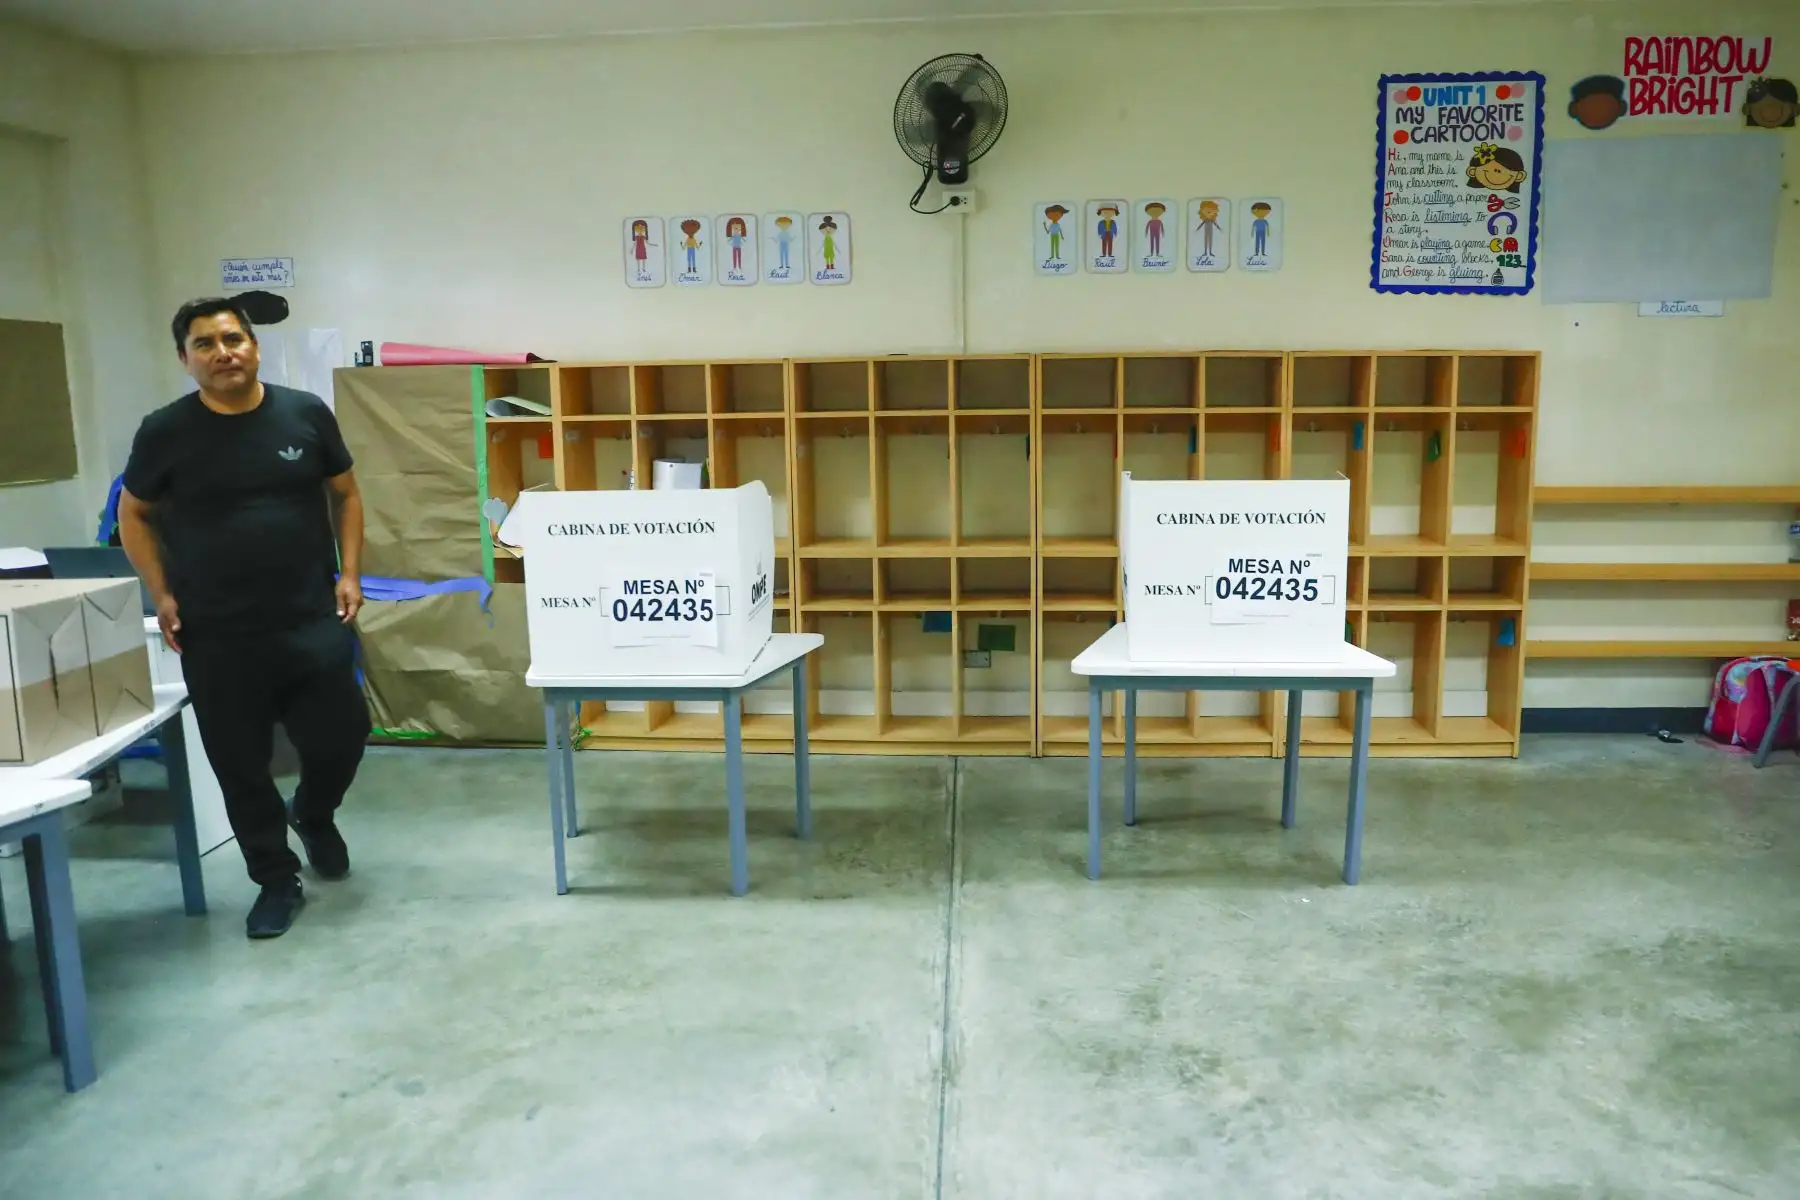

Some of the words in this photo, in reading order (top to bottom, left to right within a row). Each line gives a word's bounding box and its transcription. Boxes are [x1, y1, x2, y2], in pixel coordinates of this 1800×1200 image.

[1423, 85, 1473, 106] UNIT
[1476, 85, 1486, 105] 1
[1396, 105, 1424, 124] MY
[1410, 122, 1506, 143] CARTOON
[1409, 152, 1424, 166] my
[1426, 152, 1451, 161] name
[1455, 150, 1464, 161] is
[1388, 163, 1407, 175] Ana
[1409, 166, 1425, 175] and
[1427, 163, 1444, 175] this
[1446, 165, 1457, 175] is
[1386, 180, 1403, 192] my
[1406, 177, 1458, 189] classroom.
[1384, 192, 1410, 206] John
[1413, 194, 1421, 204] is
[1423, 190, 1455, 207] cutting
[1457, 195, 1464, 203] a
[1384, 208, 1408, 222] Rosa
[1411, 212, 1420, 222] is
[1424, 208, 1472, 226] listening
[1475, 211, 1488, 222] to
[1386, 226, 1394, 234] a
[1383, 236, 1409, 249] Omar
[1411, 239, 1419, 249] is
[1420, 238, 1453, 252] playing
[1454, 240, 1461, 249] a
[252, 258, 284, 274] cumple
[1142, 259, 1169, 268] Bruno
[1382, 250, 1403, 263] Sara
[1405, 253, 1415, 263] is
[1417, 253, 1456, 267] counting
[1382, 267, 1400, 279] and
[1402, 266, 1436, 281] George
[1437, 267, 1446, 277] is
[1656, 300, 1702, 314] lectura
[1156, 513, 1216, 525] CABINA
[1219, 513, 1240, 525] DE
[1243, 509, 1327, 525] VOTACIÓN
[547, 524, 606, 536] CABINA
[609, 523, 630, 535] DE
[633, 518, 716, 535] VOTACIÓN
[1228, 558, 1284, 574] MESA
[623, 579, 680, 595] MESA
[1144, 584, 1183, 596] MESA
[1215, 576, 1319, 602] 042435
[541, 597, 579, 608] MESA
[612, 598, 713, 622] 042435
